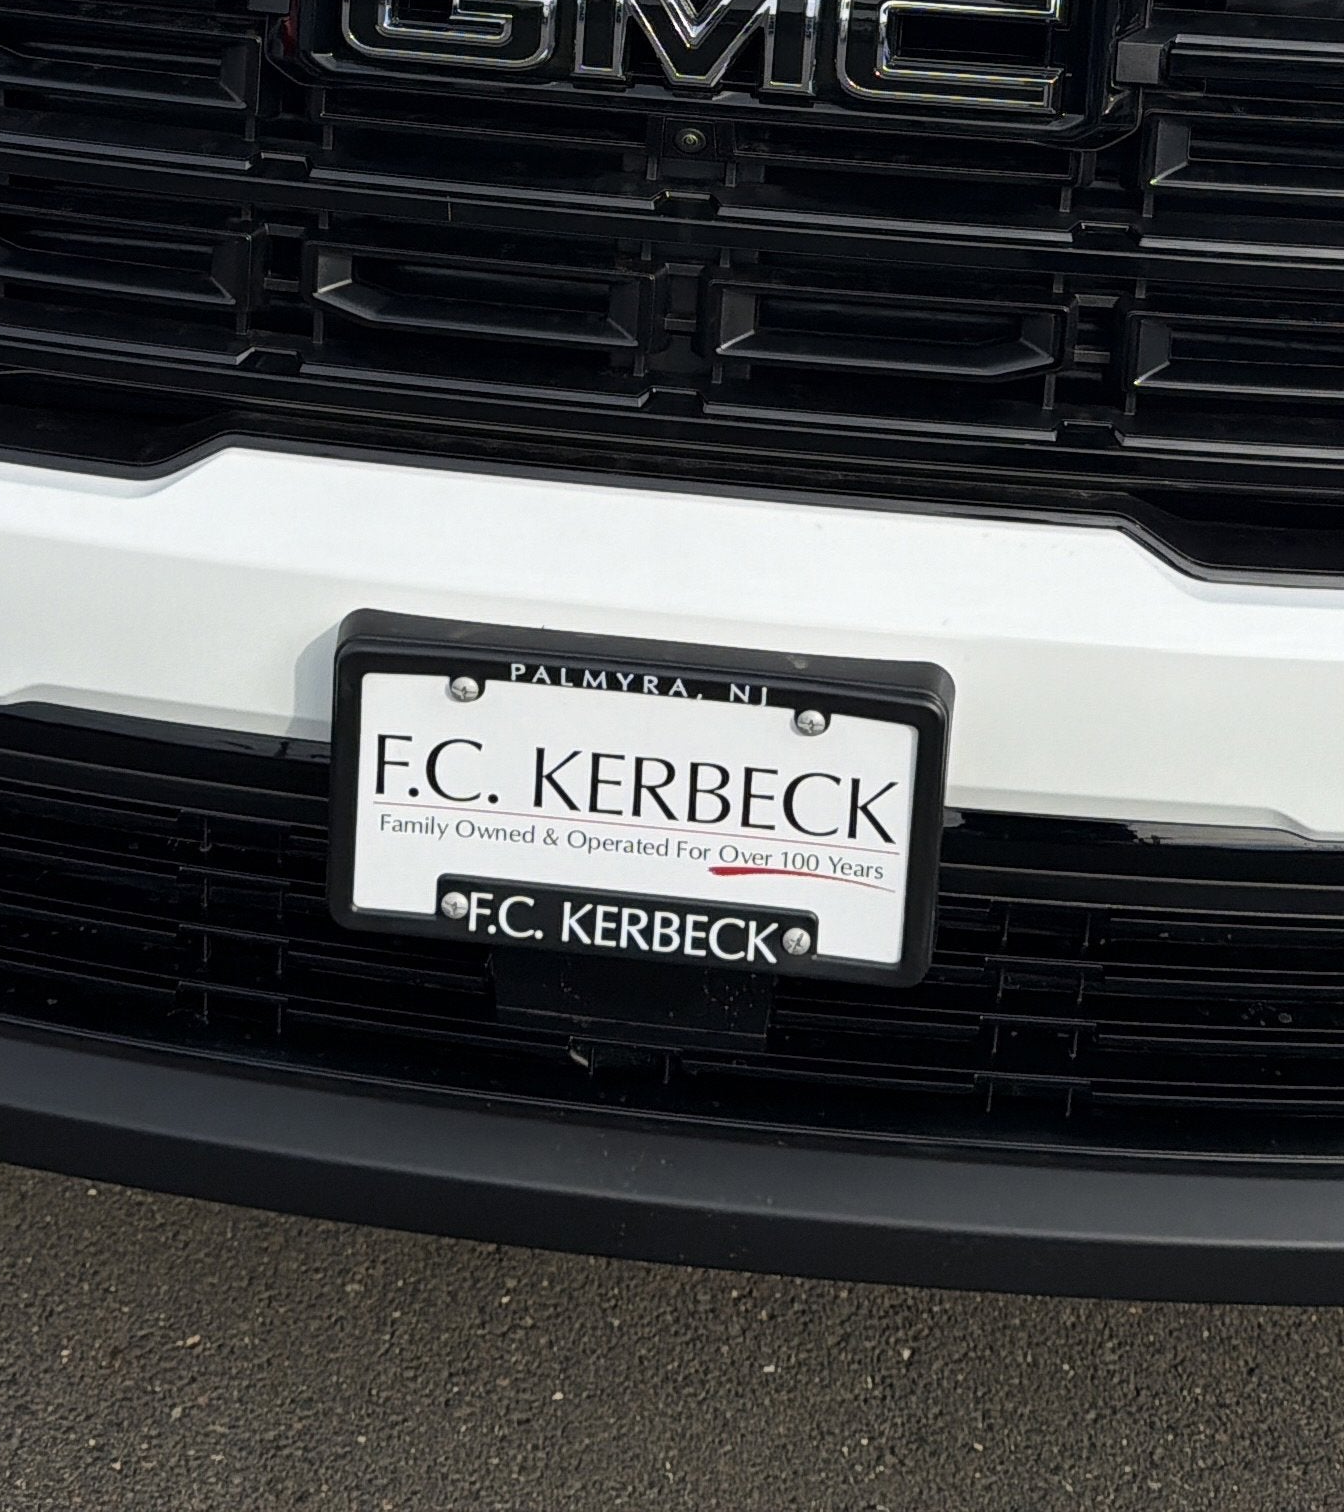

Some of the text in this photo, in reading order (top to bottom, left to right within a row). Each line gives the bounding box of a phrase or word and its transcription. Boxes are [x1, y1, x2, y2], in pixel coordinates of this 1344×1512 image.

[510, 662, 768, 707] PALMYRA, NJ
[374, 733, 900, 845] F.C. KERBECK
[379, 813, 885, 880] Family Owned & Operated For Over 100 Years
[467, 891, 779, 965] F.C. KERBECK
